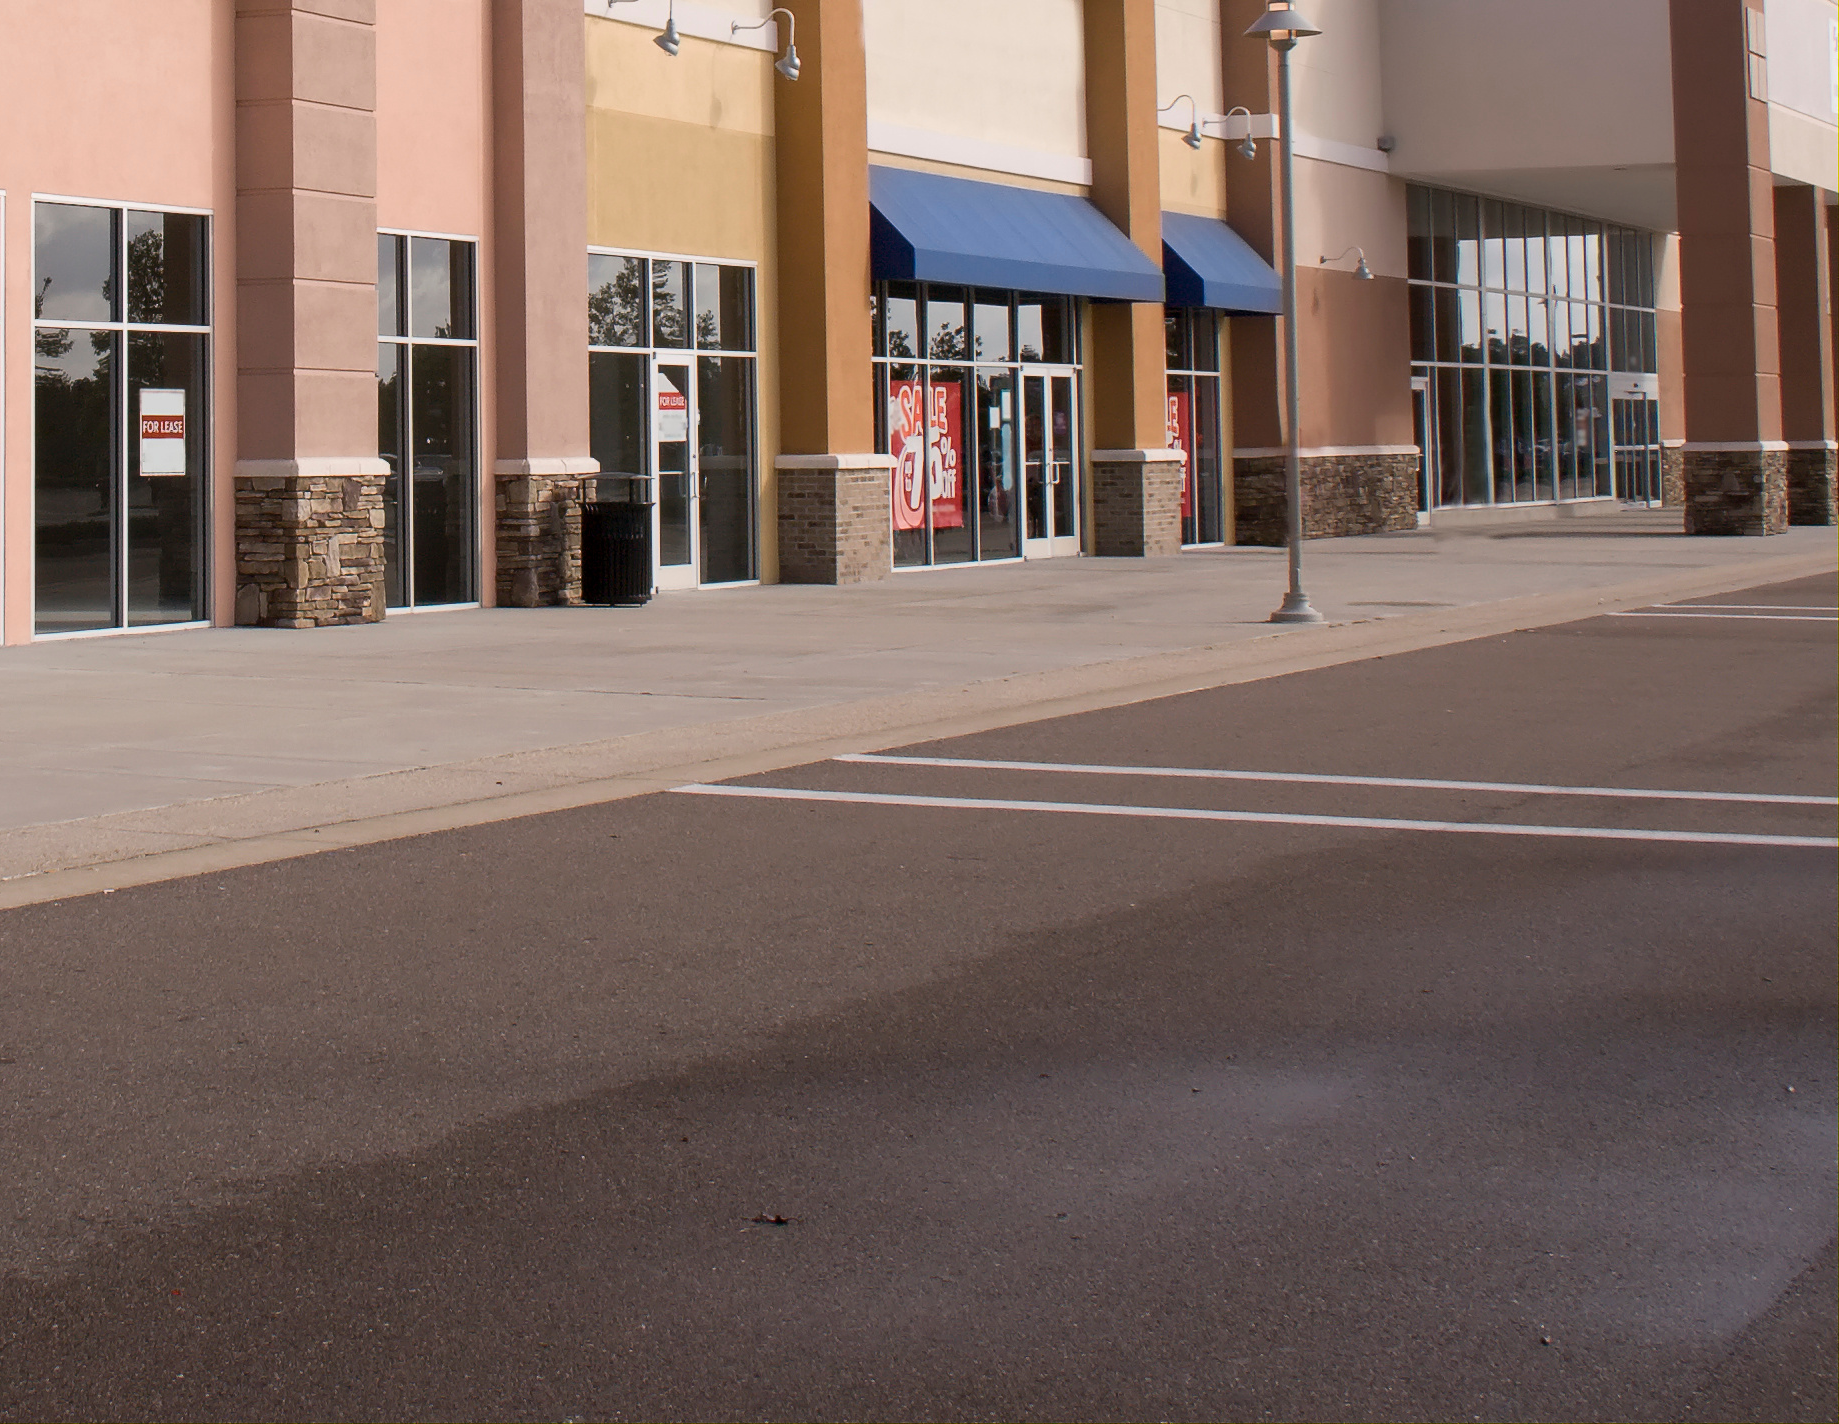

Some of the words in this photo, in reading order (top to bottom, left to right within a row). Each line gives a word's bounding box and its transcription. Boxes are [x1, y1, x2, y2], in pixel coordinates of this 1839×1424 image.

[659, 396, 670, 407] FOR
[899, 385, 948, 442] SALE
[142, 420, 159, 434] FOR
[160, 420, 183, 434] LEASE
[941, 469, 957, 499] OFF
